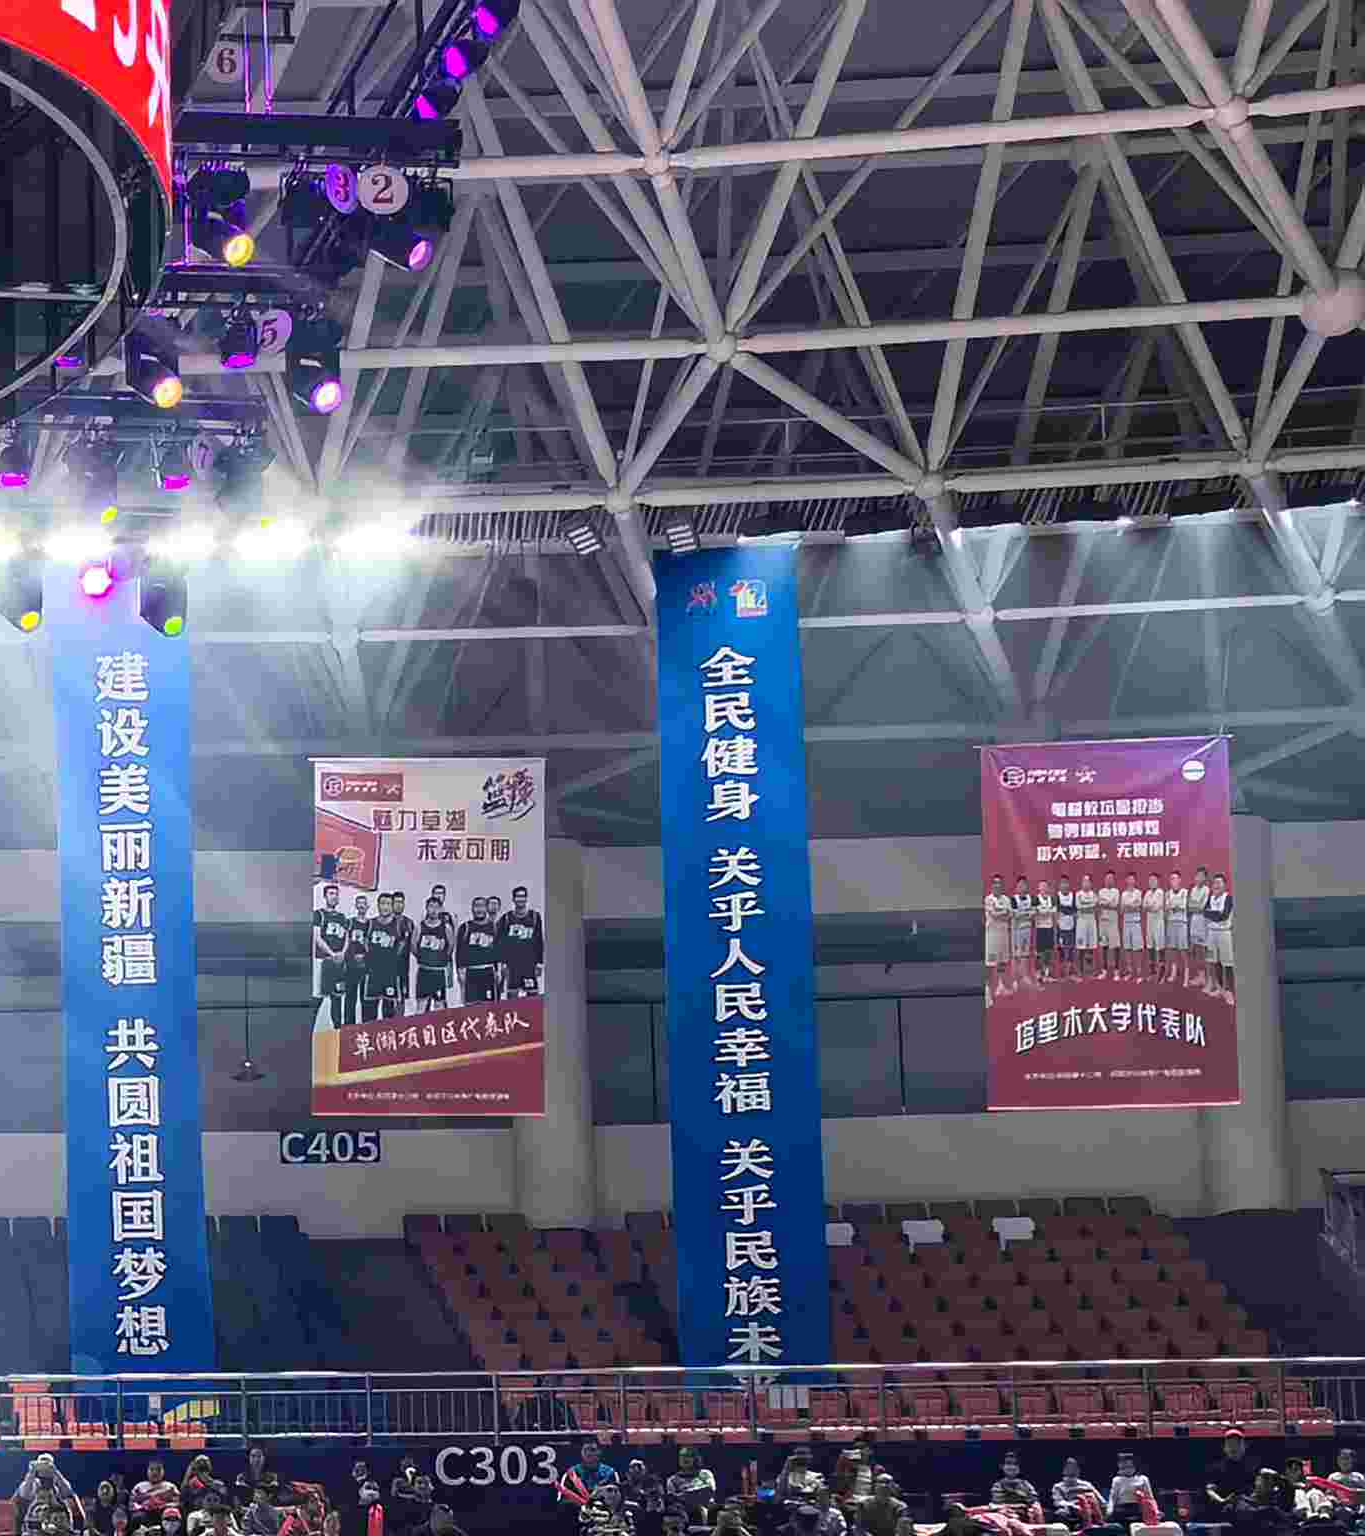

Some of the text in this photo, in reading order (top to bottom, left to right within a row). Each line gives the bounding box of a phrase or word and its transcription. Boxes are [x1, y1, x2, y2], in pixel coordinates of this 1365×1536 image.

[371, 172, 396, 204] 2
[700, 646, 759, 821] 全民健身
[418, 838, 510, 860] 未来可期
[95, 648, 170, 1356] 建设美丽新疆 共圆祖国梦想
[708, 846, 772, 1114] 关乎人民幸福
[1014, 1002, 1206, 1054] 塔里木大学代表队
[281, 1131, 379, 1163] C405
[435, 1446, 558, 1485] C303
